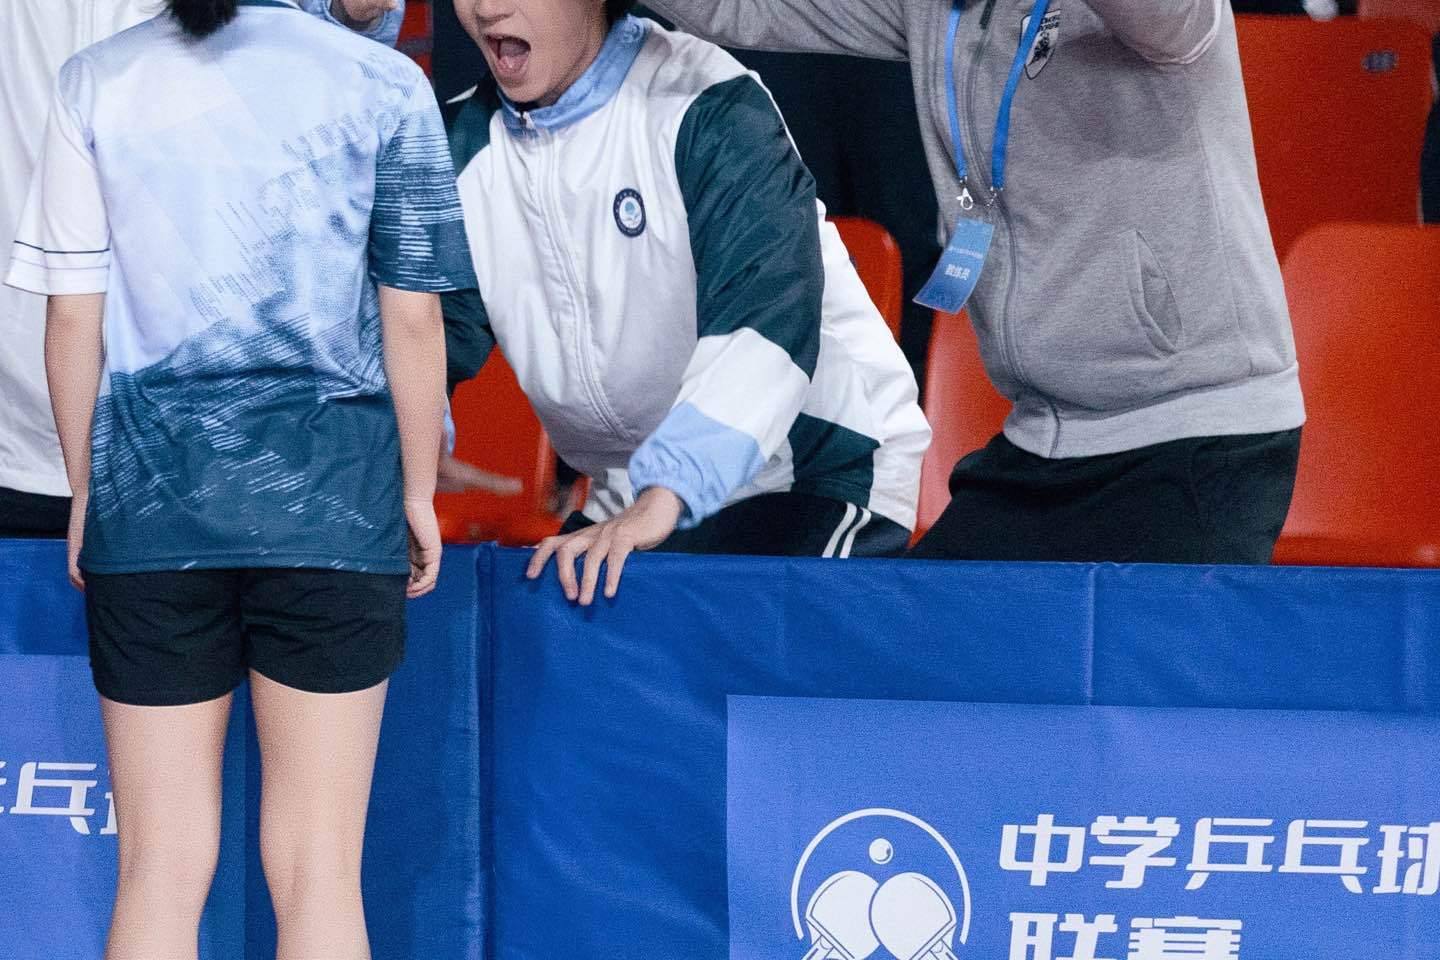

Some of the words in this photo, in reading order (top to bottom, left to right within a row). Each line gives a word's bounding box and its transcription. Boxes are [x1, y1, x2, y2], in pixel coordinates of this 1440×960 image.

[998, 814, 1440, 896] 中学乒乓球
